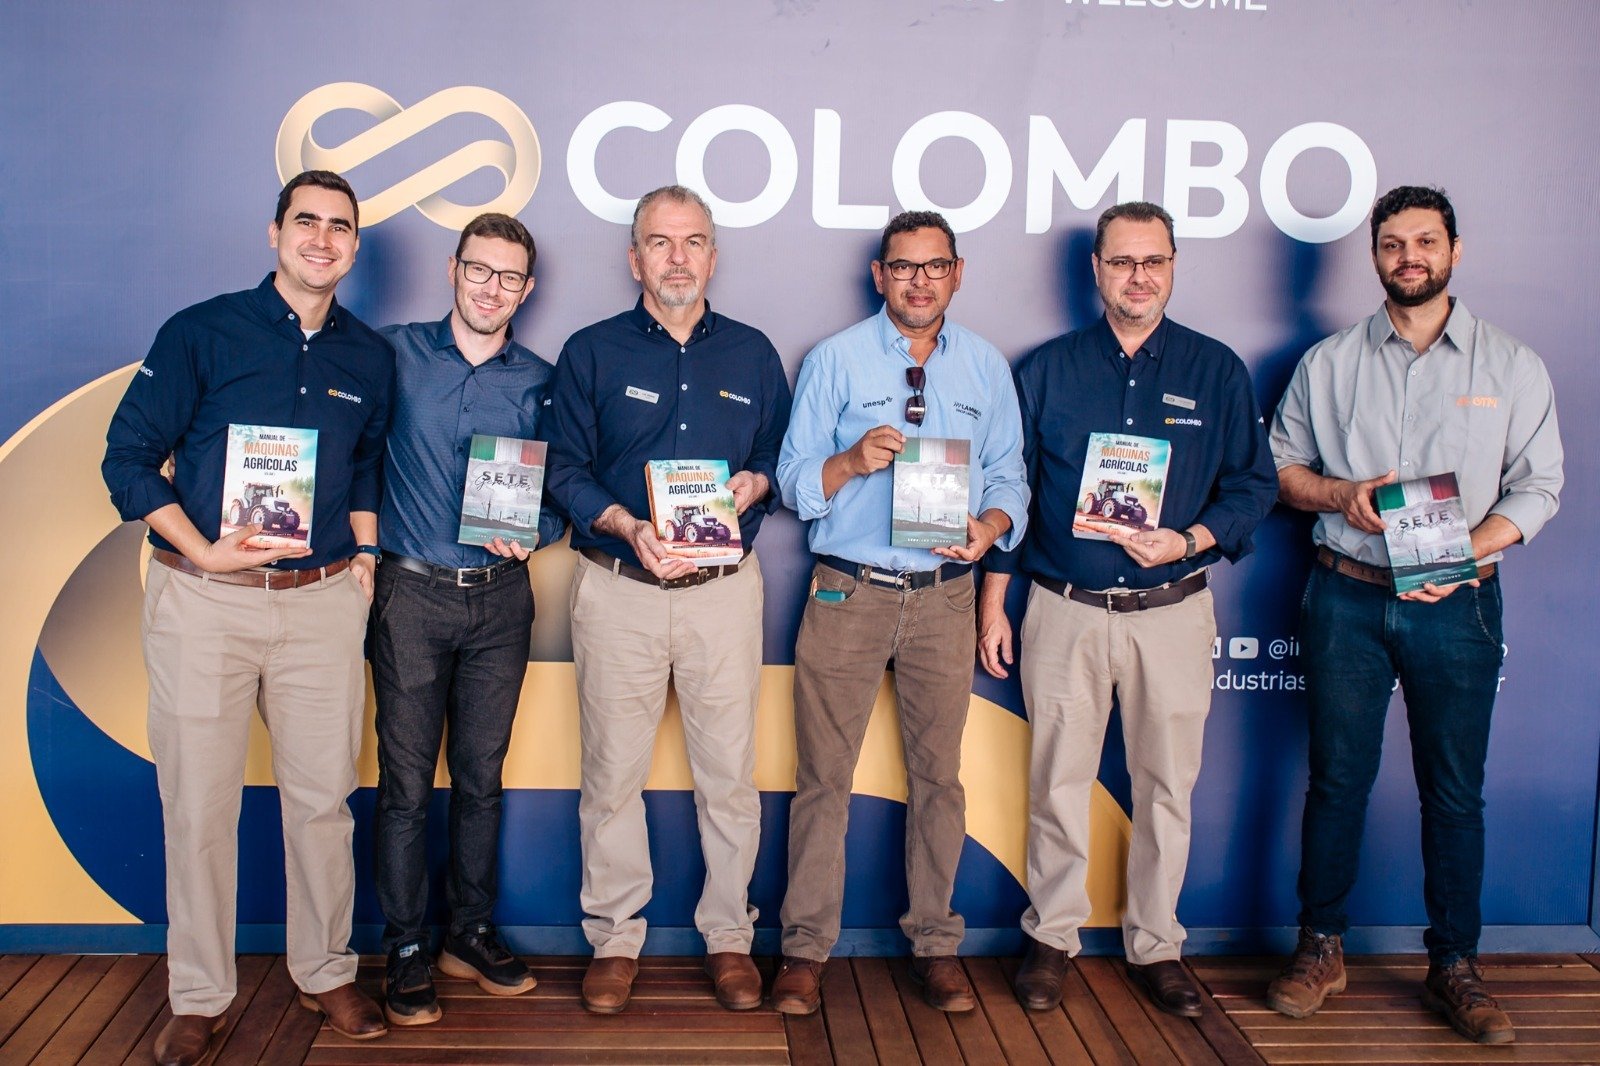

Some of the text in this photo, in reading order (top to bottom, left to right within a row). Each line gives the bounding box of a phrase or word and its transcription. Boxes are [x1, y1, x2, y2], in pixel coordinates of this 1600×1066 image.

[566, 100, 1378, 244] COLOMBO
[862, 399, 886, 409] unesp
[259, 433, 279, 441] MANUAL
[244, 440, 300, 457] MÁQUINAS
[243, 455, 298, 472] AGRÍCOLAS
[1099, 458, 1149, 474] AGRÍCOLAS
[482, 470, 530, 486] SETE
[668, 483, 717, 495] AGRÍCOLAS
[1399, 509, 1449, 529] SETE
